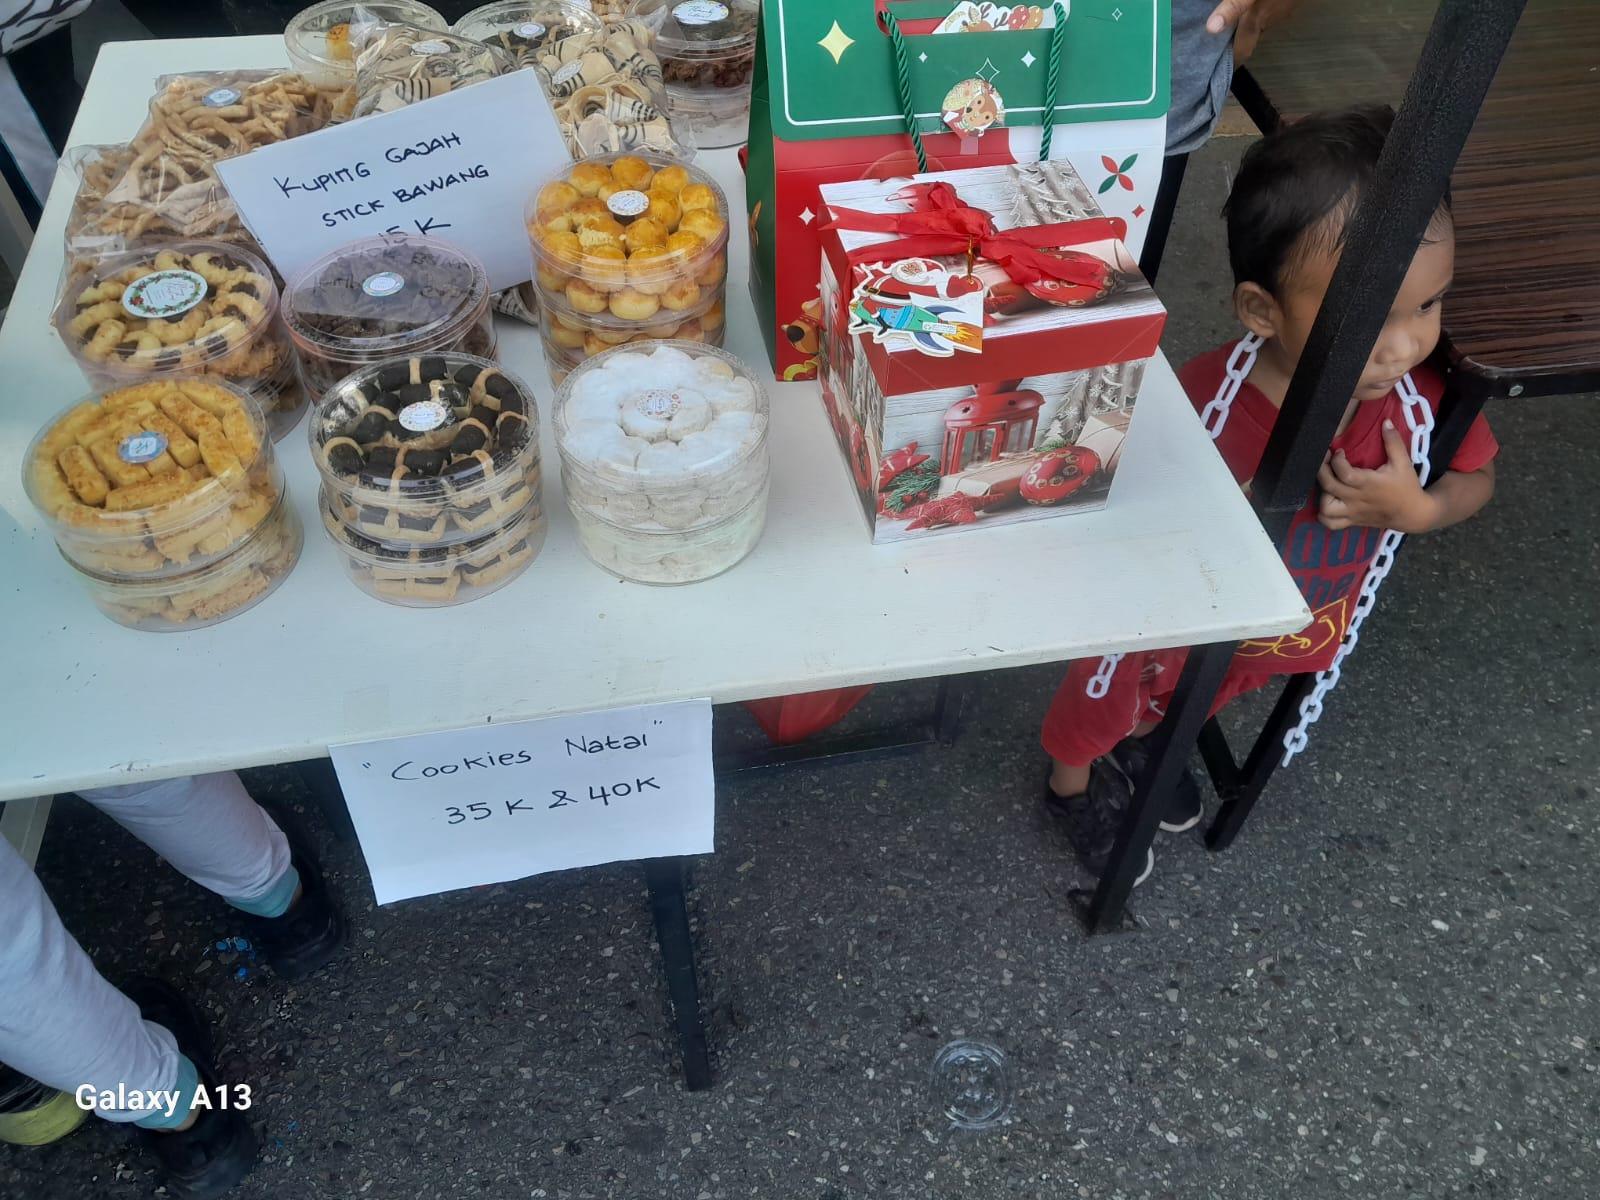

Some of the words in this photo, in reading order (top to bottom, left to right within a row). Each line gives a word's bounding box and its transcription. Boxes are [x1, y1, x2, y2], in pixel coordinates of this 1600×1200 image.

[385, 132, 461, 163] GAJAH
[322, 200, 385, 227] STICK
[392, 165, 489, 203] BAWANG
[548, 790, 578, 809] &
[589, 777, 661, 806] 40K
